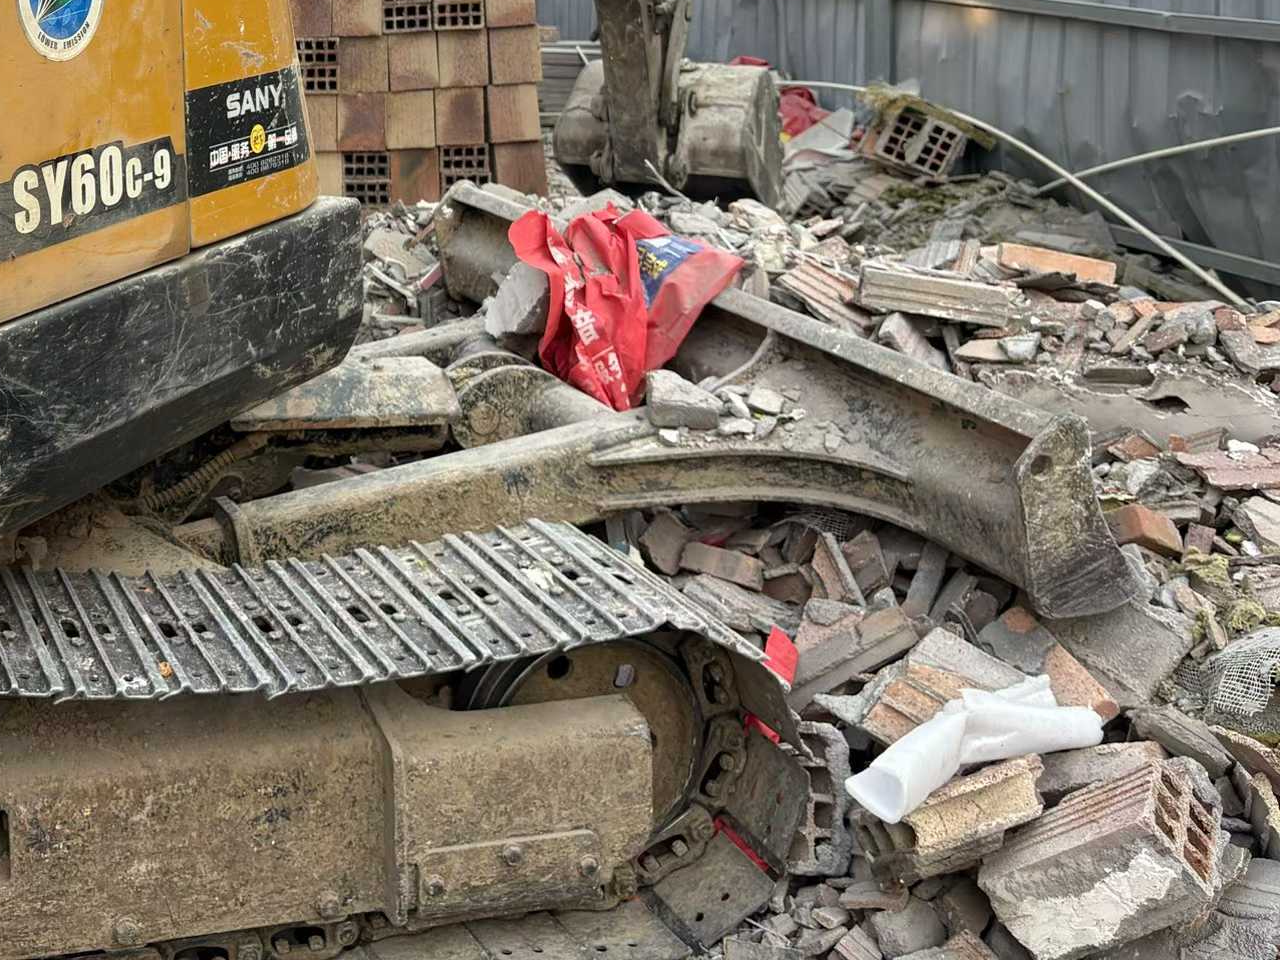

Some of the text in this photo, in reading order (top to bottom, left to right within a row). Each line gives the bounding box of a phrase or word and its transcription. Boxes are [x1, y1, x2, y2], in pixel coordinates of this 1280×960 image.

[37, 21, 90, 50] LOWER EMISSION
[226, 83, 283, 119] SANY
